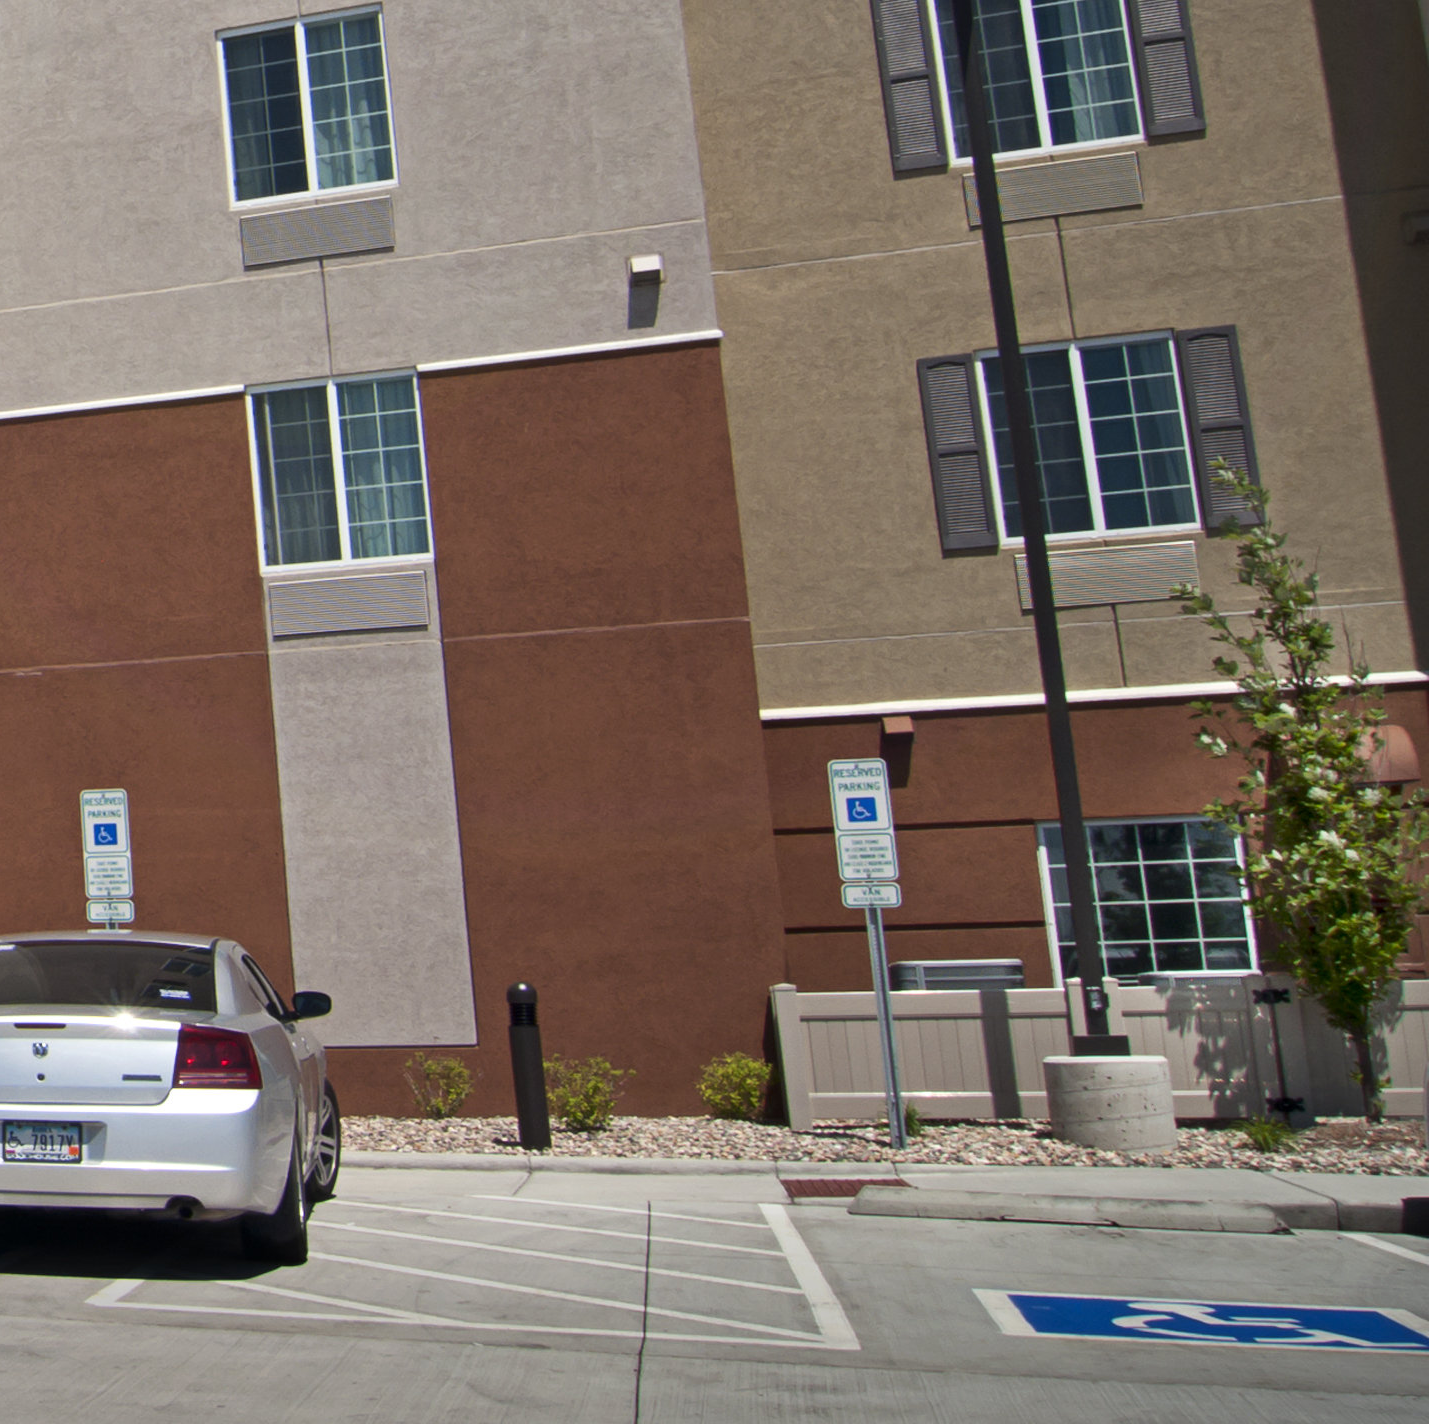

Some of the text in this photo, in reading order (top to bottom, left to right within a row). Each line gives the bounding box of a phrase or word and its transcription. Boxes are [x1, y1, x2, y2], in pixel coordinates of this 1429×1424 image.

[833, 767, 882, 778] RESERVED
[838, 781, 881, 792] PARKING
[84, 796, 123, 806] RESERVED
[87, 809, 122, 818] PARKING
[861, 888, 881, 896] VAN
[31, 1134, 74, 1152] 7917V
